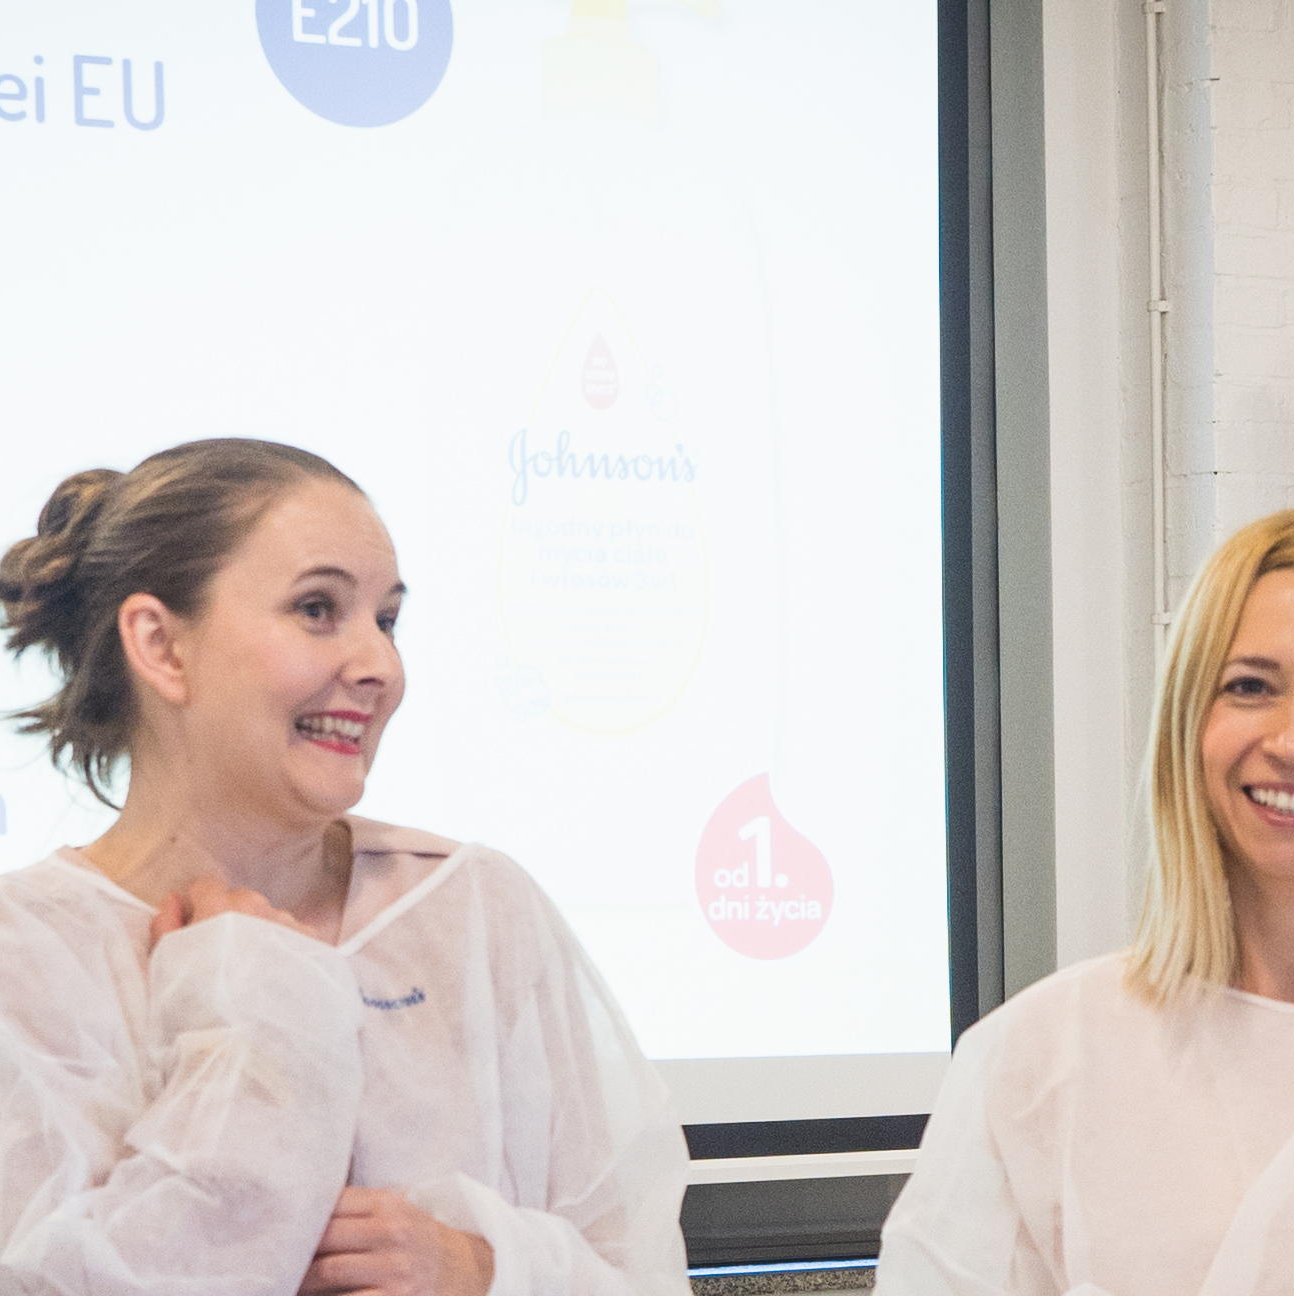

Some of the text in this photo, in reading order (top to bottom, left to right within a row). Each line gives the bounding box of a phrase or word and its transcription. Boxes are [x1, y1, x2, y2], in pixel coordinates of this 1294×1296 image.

[292, 0, 418, 51] E210
[72, 55, 166, 132] EU
[713, 861, 750, 887] od
[708, 893, 822, 926] dni życia
